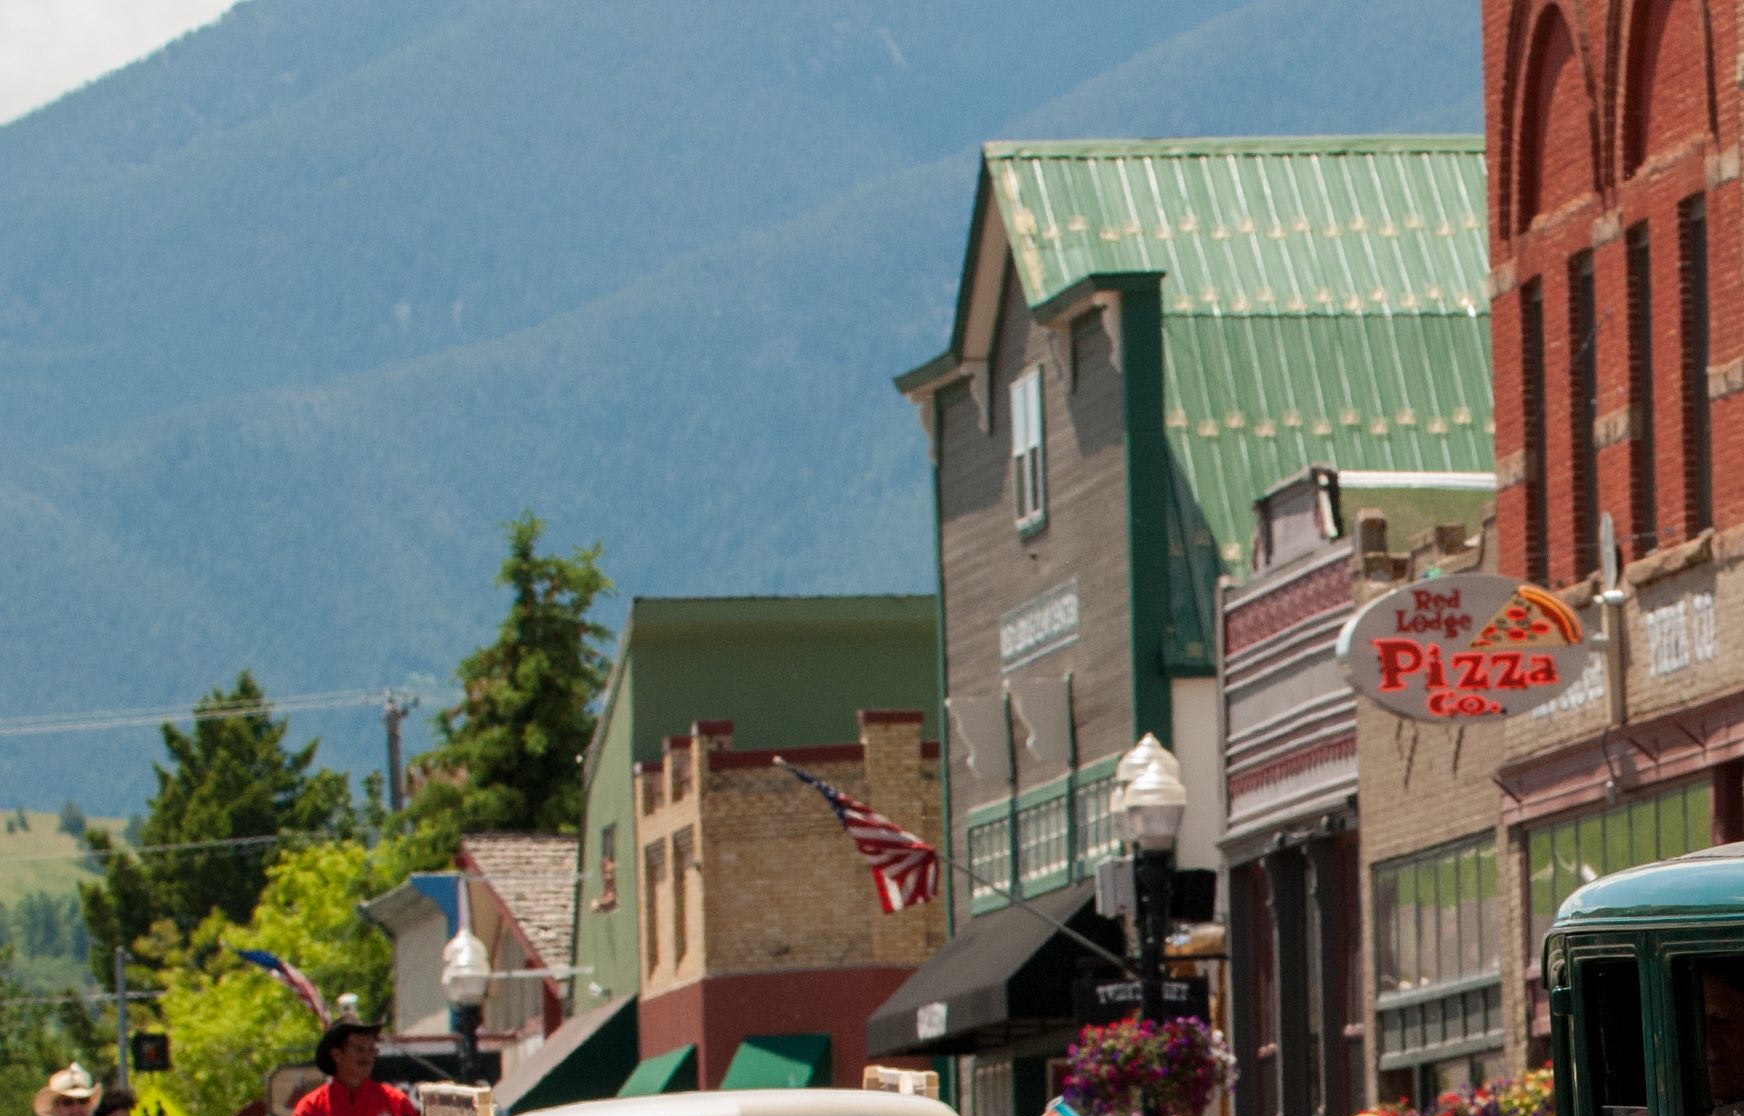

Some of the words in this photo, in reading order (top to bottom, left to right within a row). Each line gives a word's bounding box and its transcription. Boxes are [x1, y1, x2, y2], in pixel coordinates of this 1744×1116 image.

[1411, 586, 1461, 611] Red
[1395, 610, 1474, 639] Lodge
[1371, 637, 1559, 692] Pizza
[1426, 691, 1502, 717] Co.
